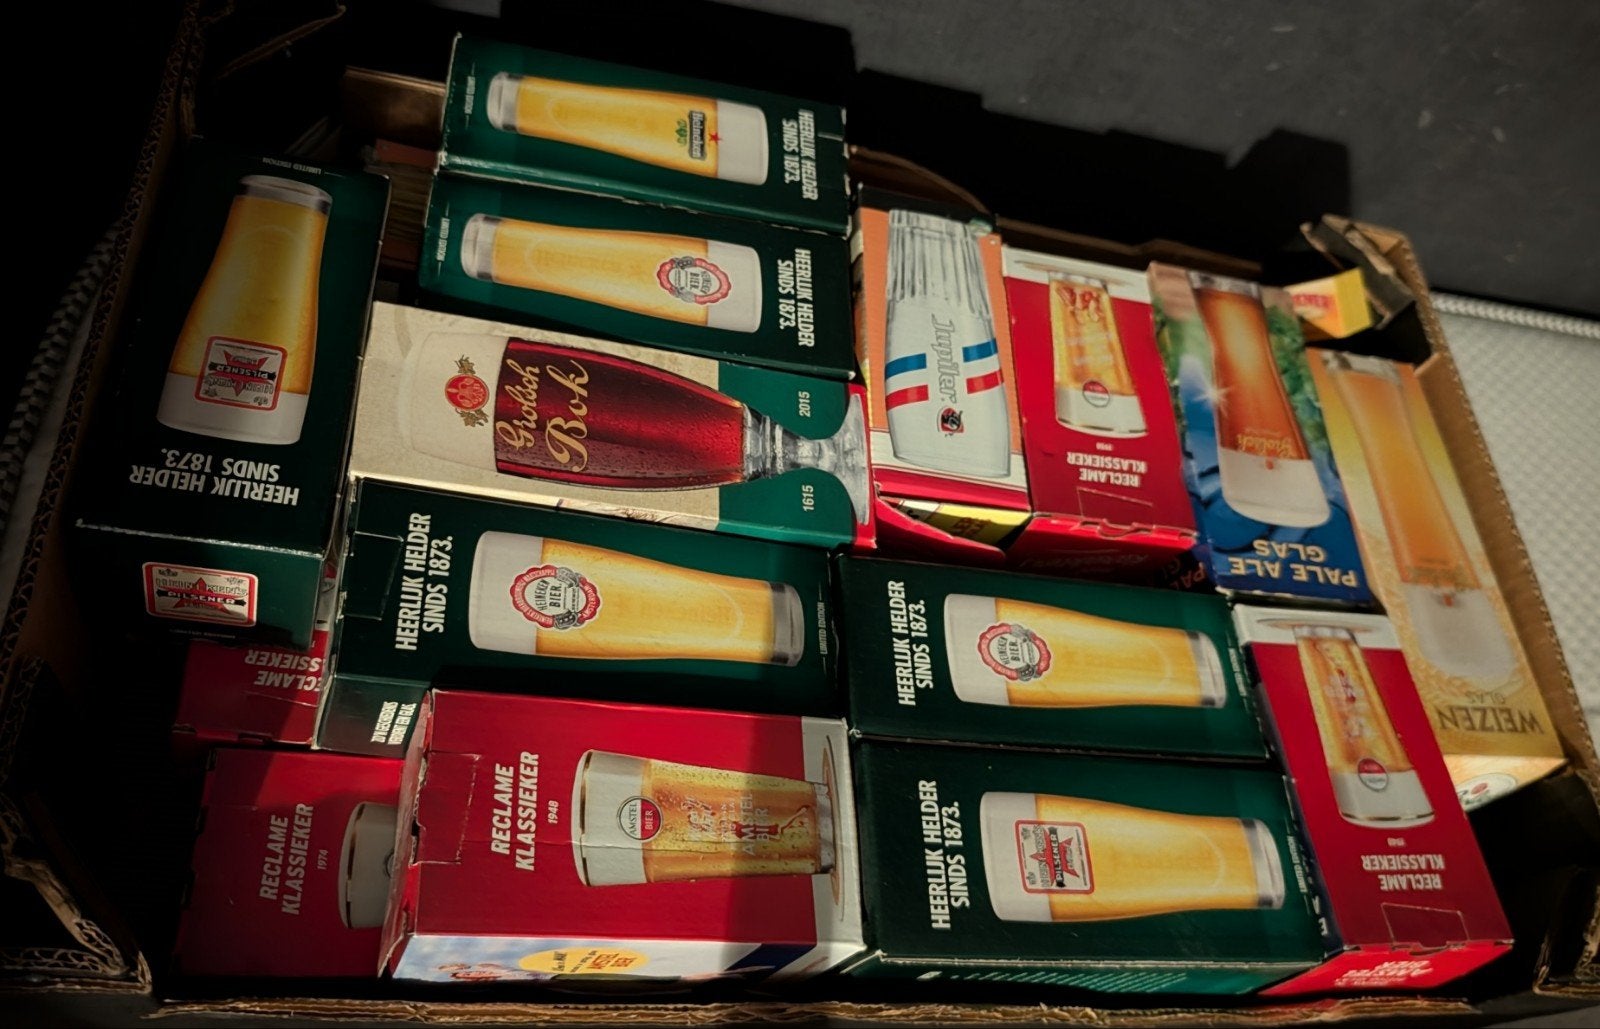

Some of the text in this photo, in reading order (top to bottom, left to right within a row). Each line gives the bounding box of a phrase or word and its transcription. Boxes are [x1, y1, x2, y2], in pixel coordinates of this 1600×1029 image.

[782, 118, 800, 184] SINDS 1873.
[798, 109, 819, 201] HEERLIJK HELDER
[776, 259, 795, 330] SINDS 1873.
[794, 248, 815, 347] HEERLIJK HELDER
[217, 365, 269, 380] PILSENER
[495, 357, 541, 451] Grolsch
[545, 359, 591, 473] Bok
[799, 391, 811, 418] 2015
[161, 448, 281, 482] SINDS 1873.
[1066, 451, 1148, 474] KLASSIEKER
[1079, 468, 1141, 488] RECLAME
[129, 464, 300, 506] HEERLIJK HELDER
[802, 484, 814, 512] 1615
[1252, 539, 1327, 563] GLAS
[394, 512, 432, 651] HEERLIJK HELDER
[423, 534, 454, 634] SINDS 1873.
[1170, 562, 1206, 591] PAL
[1228, 556, 1360, 588] PALE ALE
[167, 590, 236, 604] PILSENER
[534, 579, 550, 611] HEINEKEN
[244, 650, 322, 672] SSIEKER
[887, 580, 917, 706] HEERLIJK HELDER
[909, 599, 934, 690] SINDS 1873.
[253, 670, 322, 692] ECLAME
[1434, 705, 1545, 735] WEIZEN
[490, 762, 515, 855] RECLAME
[515, 751, 540, 872] KLASSIEKER
[628, 803, 638, 836] AMSTEL
[644, 809, 654, 830] BIER
[741, 793, 756, 856] AMSTEL
[258, 814, 289, 900] RECLAME
[281, 803, 314, 916] KLASSIEKER
[316, 849, 329, 870] 1974
[918, 779, 951, 930] HEERLIJK HELDER
[941, 801, 970, 909] SINDS 1873.
[1050, 833, 1063, 881] PILSENER
[1361, 854, 1445, 871] KLASSIEKER
[1379, 873, 1442, 891] RECLAME
